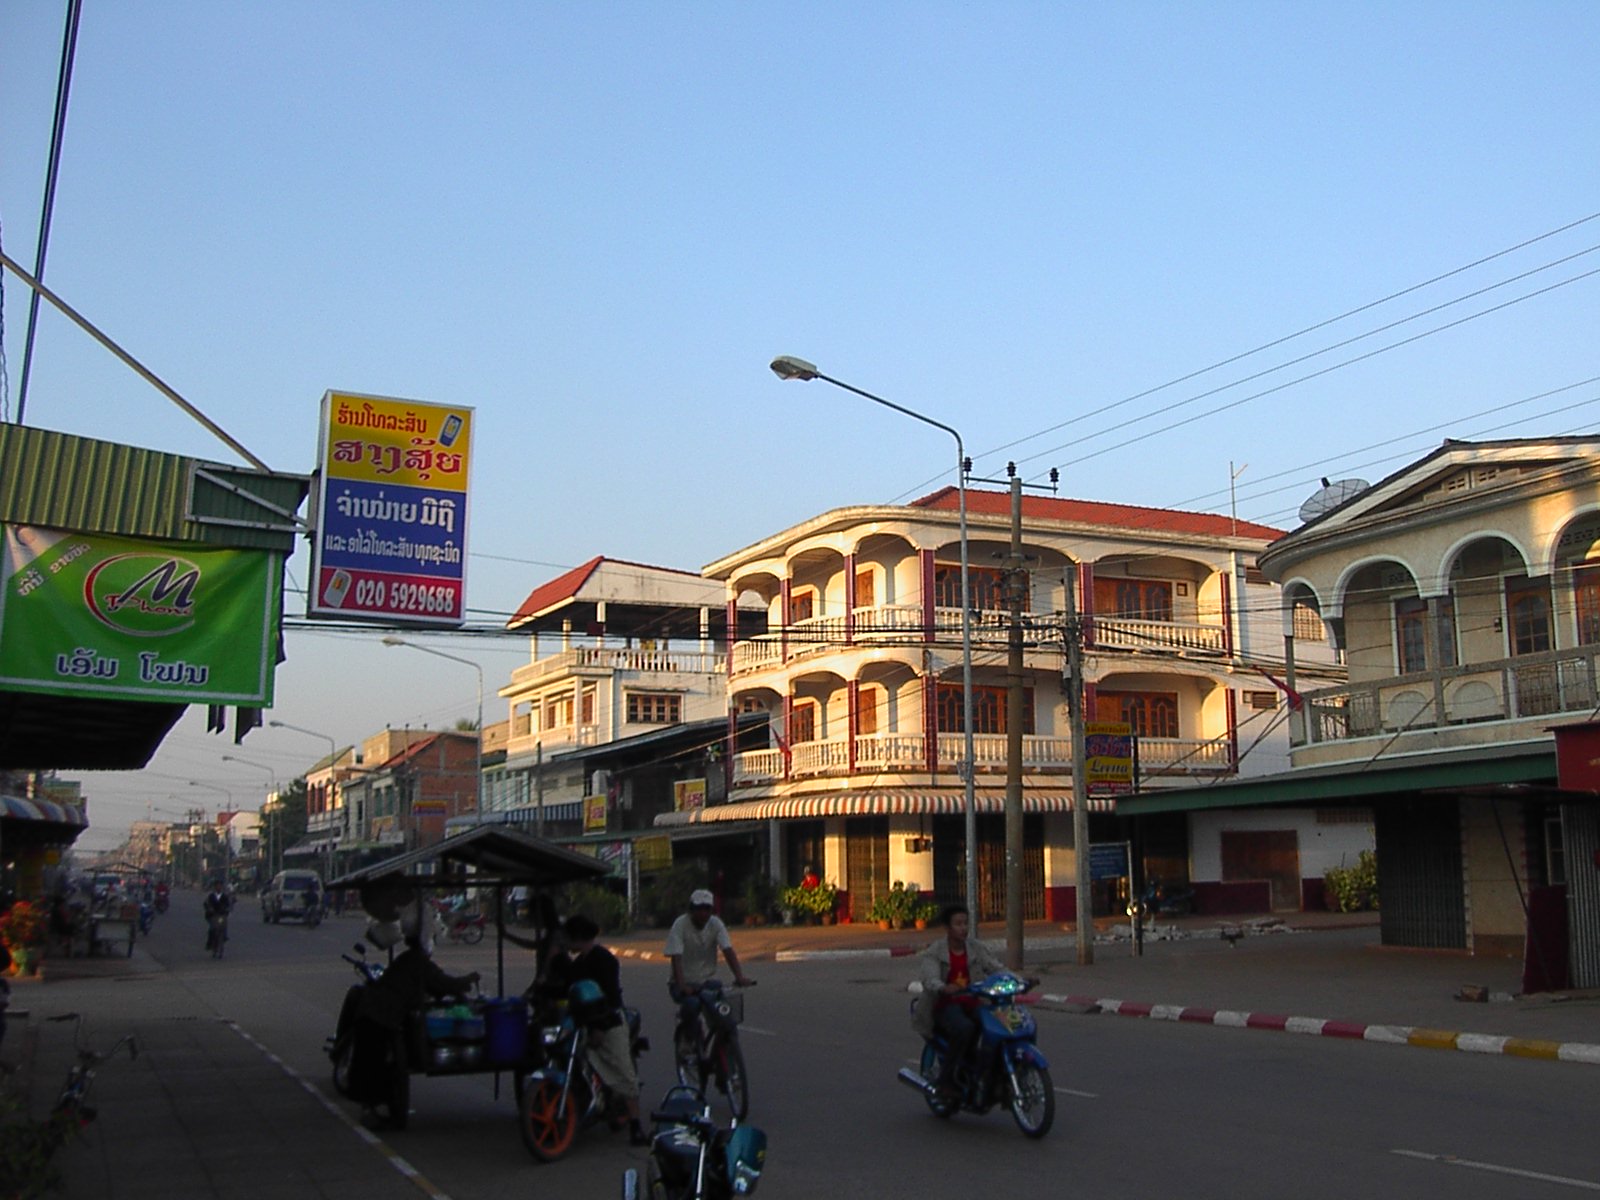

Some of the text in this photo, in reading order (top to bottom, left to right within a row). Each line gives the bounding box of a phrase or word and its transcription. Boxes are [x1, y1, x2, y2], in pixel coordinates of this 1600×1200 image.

[355, 579, 454, 613] 020 5929688
[56, 647, 119, 679] ເອັມ
